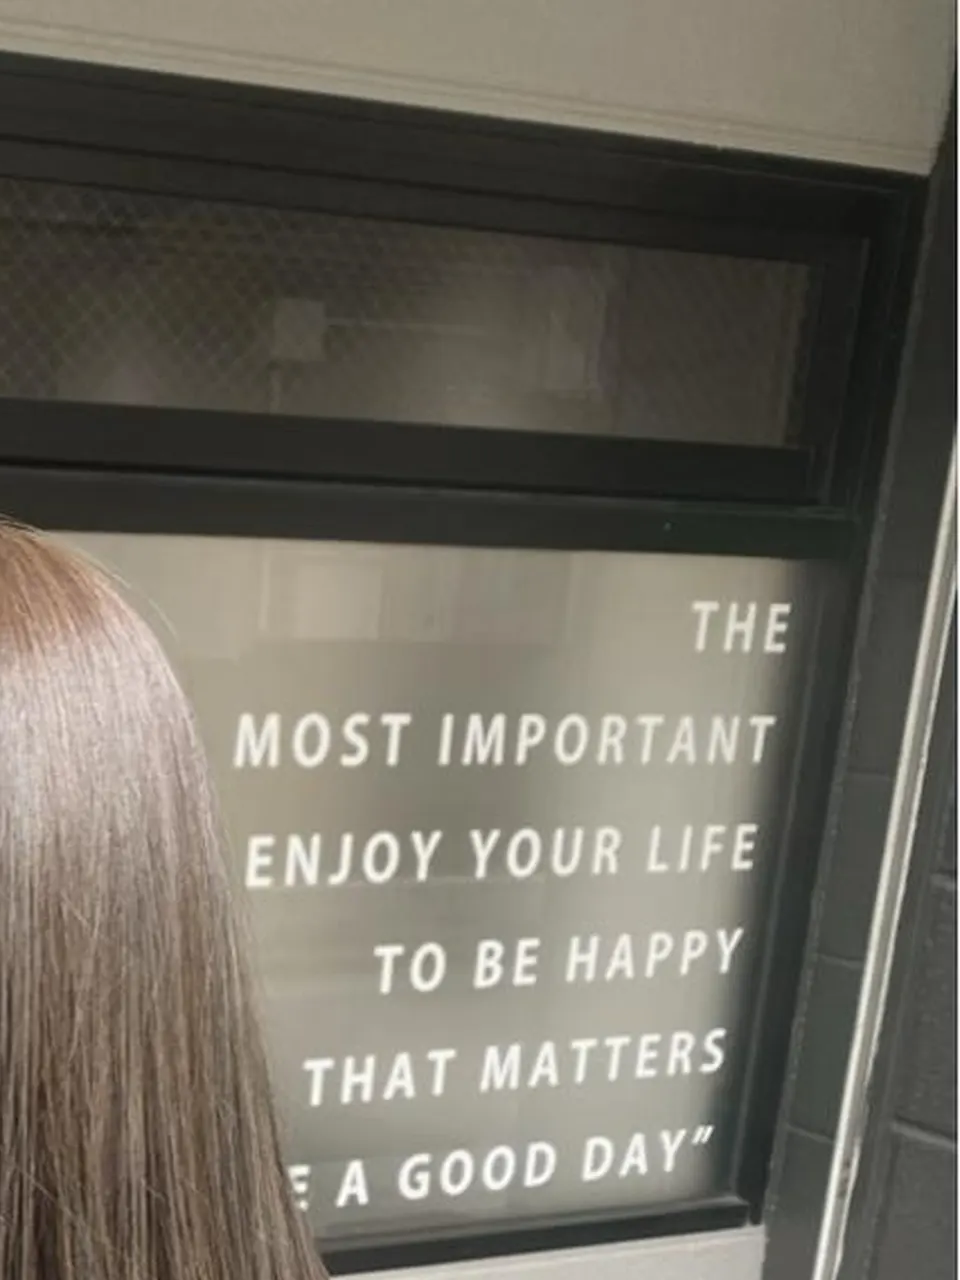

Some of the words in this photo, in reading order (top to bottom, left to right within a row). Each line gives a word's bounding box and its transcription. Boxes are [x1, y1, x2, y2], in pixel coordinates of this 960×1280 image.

[693, 602, 791, 653] THE
[234, 713, 411, 767] MOST
[439, 714, 776, 765] IMPORTANT
[246, 830, 442, 887] ENJOY
[470, 828, 620, 879] YOUR
[648, 824, 758, 871] LIFE
[374, 942, 445, 994] TO
[474, 938, 540, 988] BE
[567, 927, 744, 981] HAPPY
[304, 1049, 456, 1106] THAT
[480, 1028, 726, 1091] MATTERS
[336, 1160, 368, 1207] A
[398, 1142, 556, 1200] GOOD
